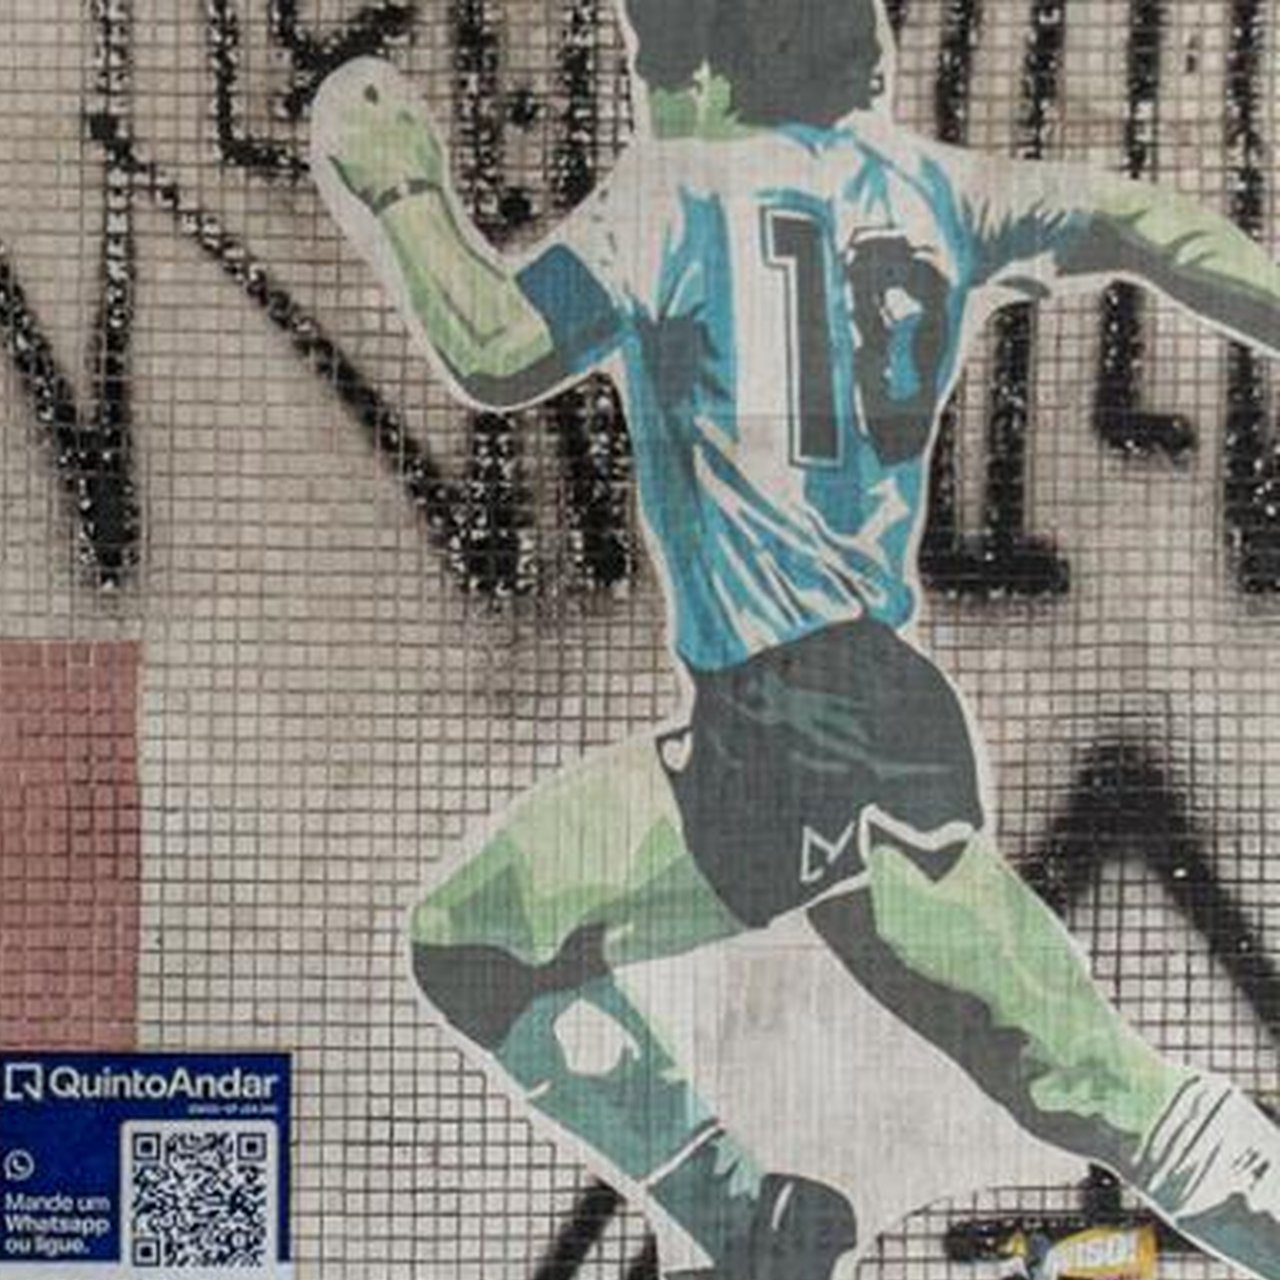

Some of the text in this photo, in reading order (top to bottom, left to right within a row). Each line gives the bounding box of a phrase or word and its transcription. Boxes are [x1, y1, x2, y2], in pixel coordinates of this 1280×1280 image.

[760, 203, 951, 468] 10
[49, 1065, 278, 1100] QuintoAndar
[4, 1191, 111, 1212] Mande um
[4, 1236, 91, 1257] ou ligue.
